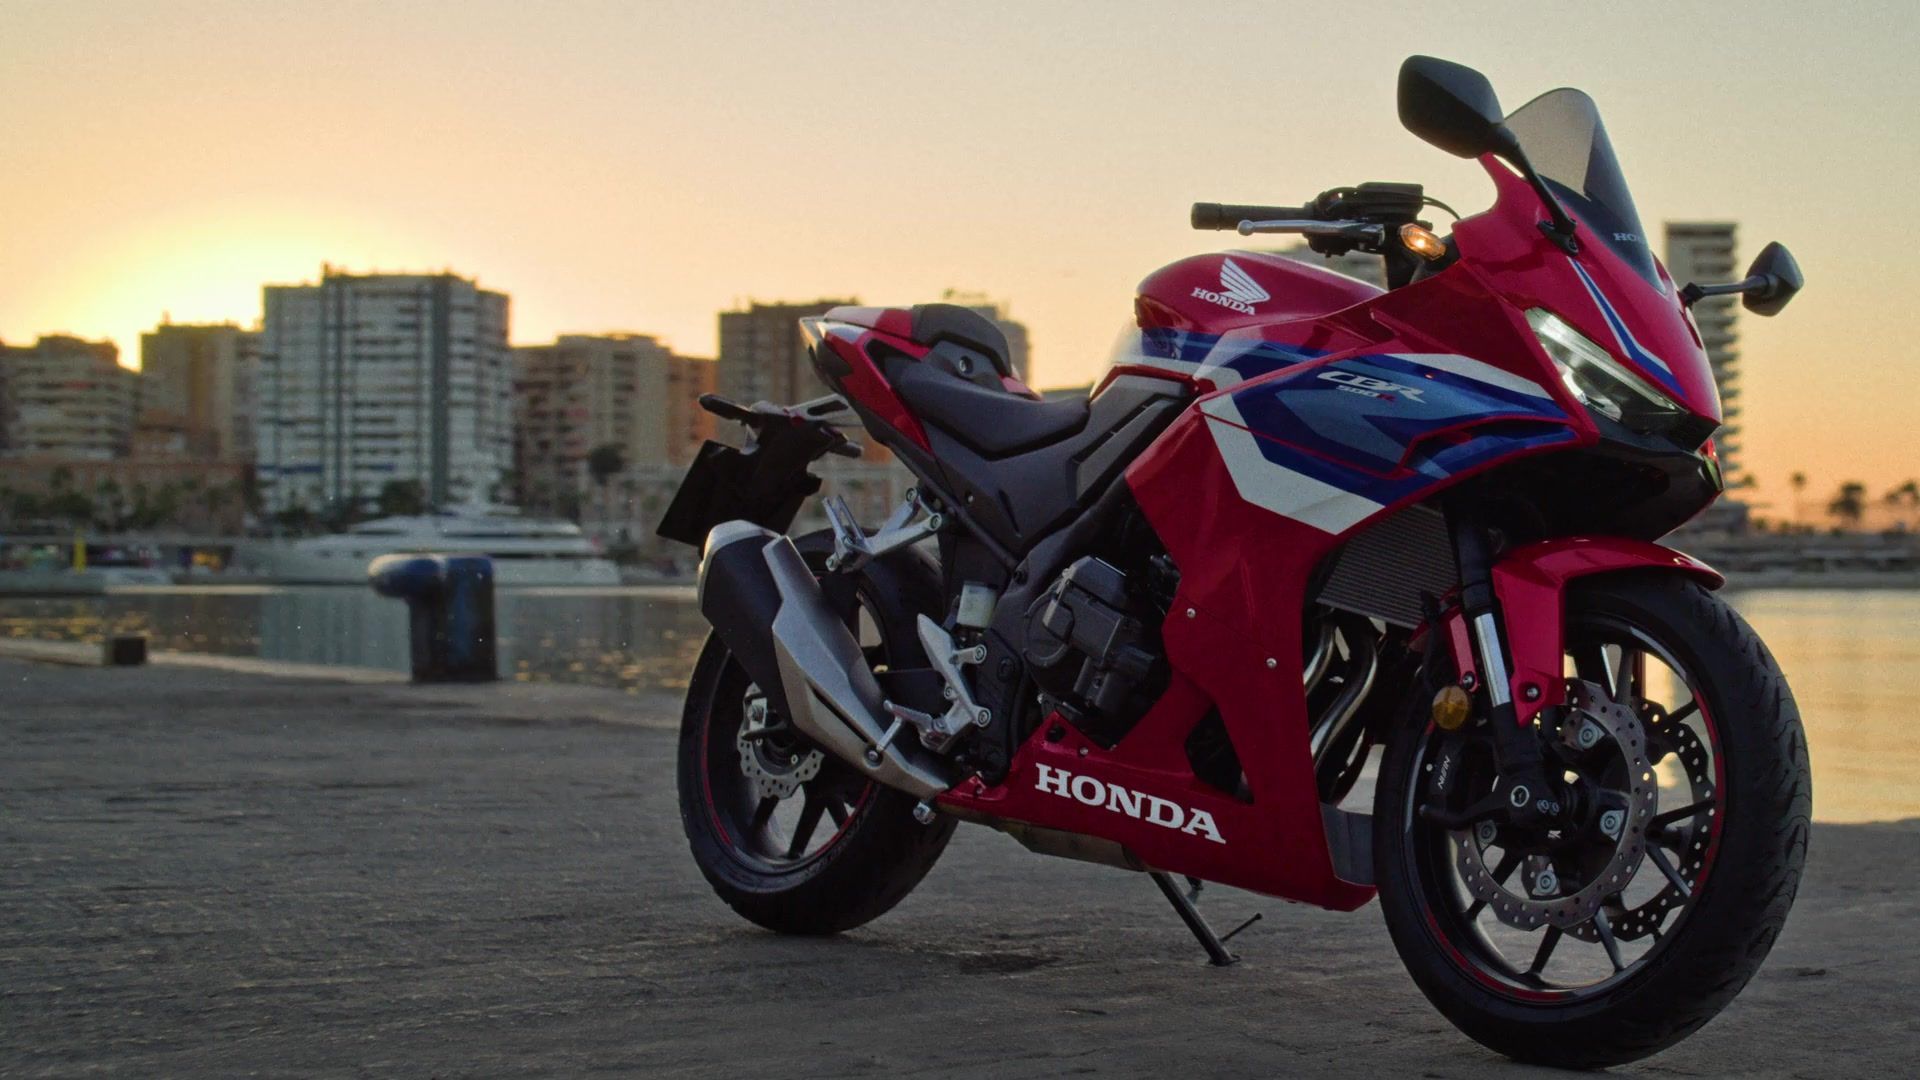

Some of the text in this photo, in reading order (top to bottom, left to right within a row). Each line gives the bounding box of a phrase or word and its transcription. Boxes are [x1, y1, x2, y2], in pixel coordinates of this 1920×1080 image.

[1190, 287, 1255, 316] HONDA
[1316, 370, 1427, 404] CBR
[1034, 762, 1227, 845] HONDA
